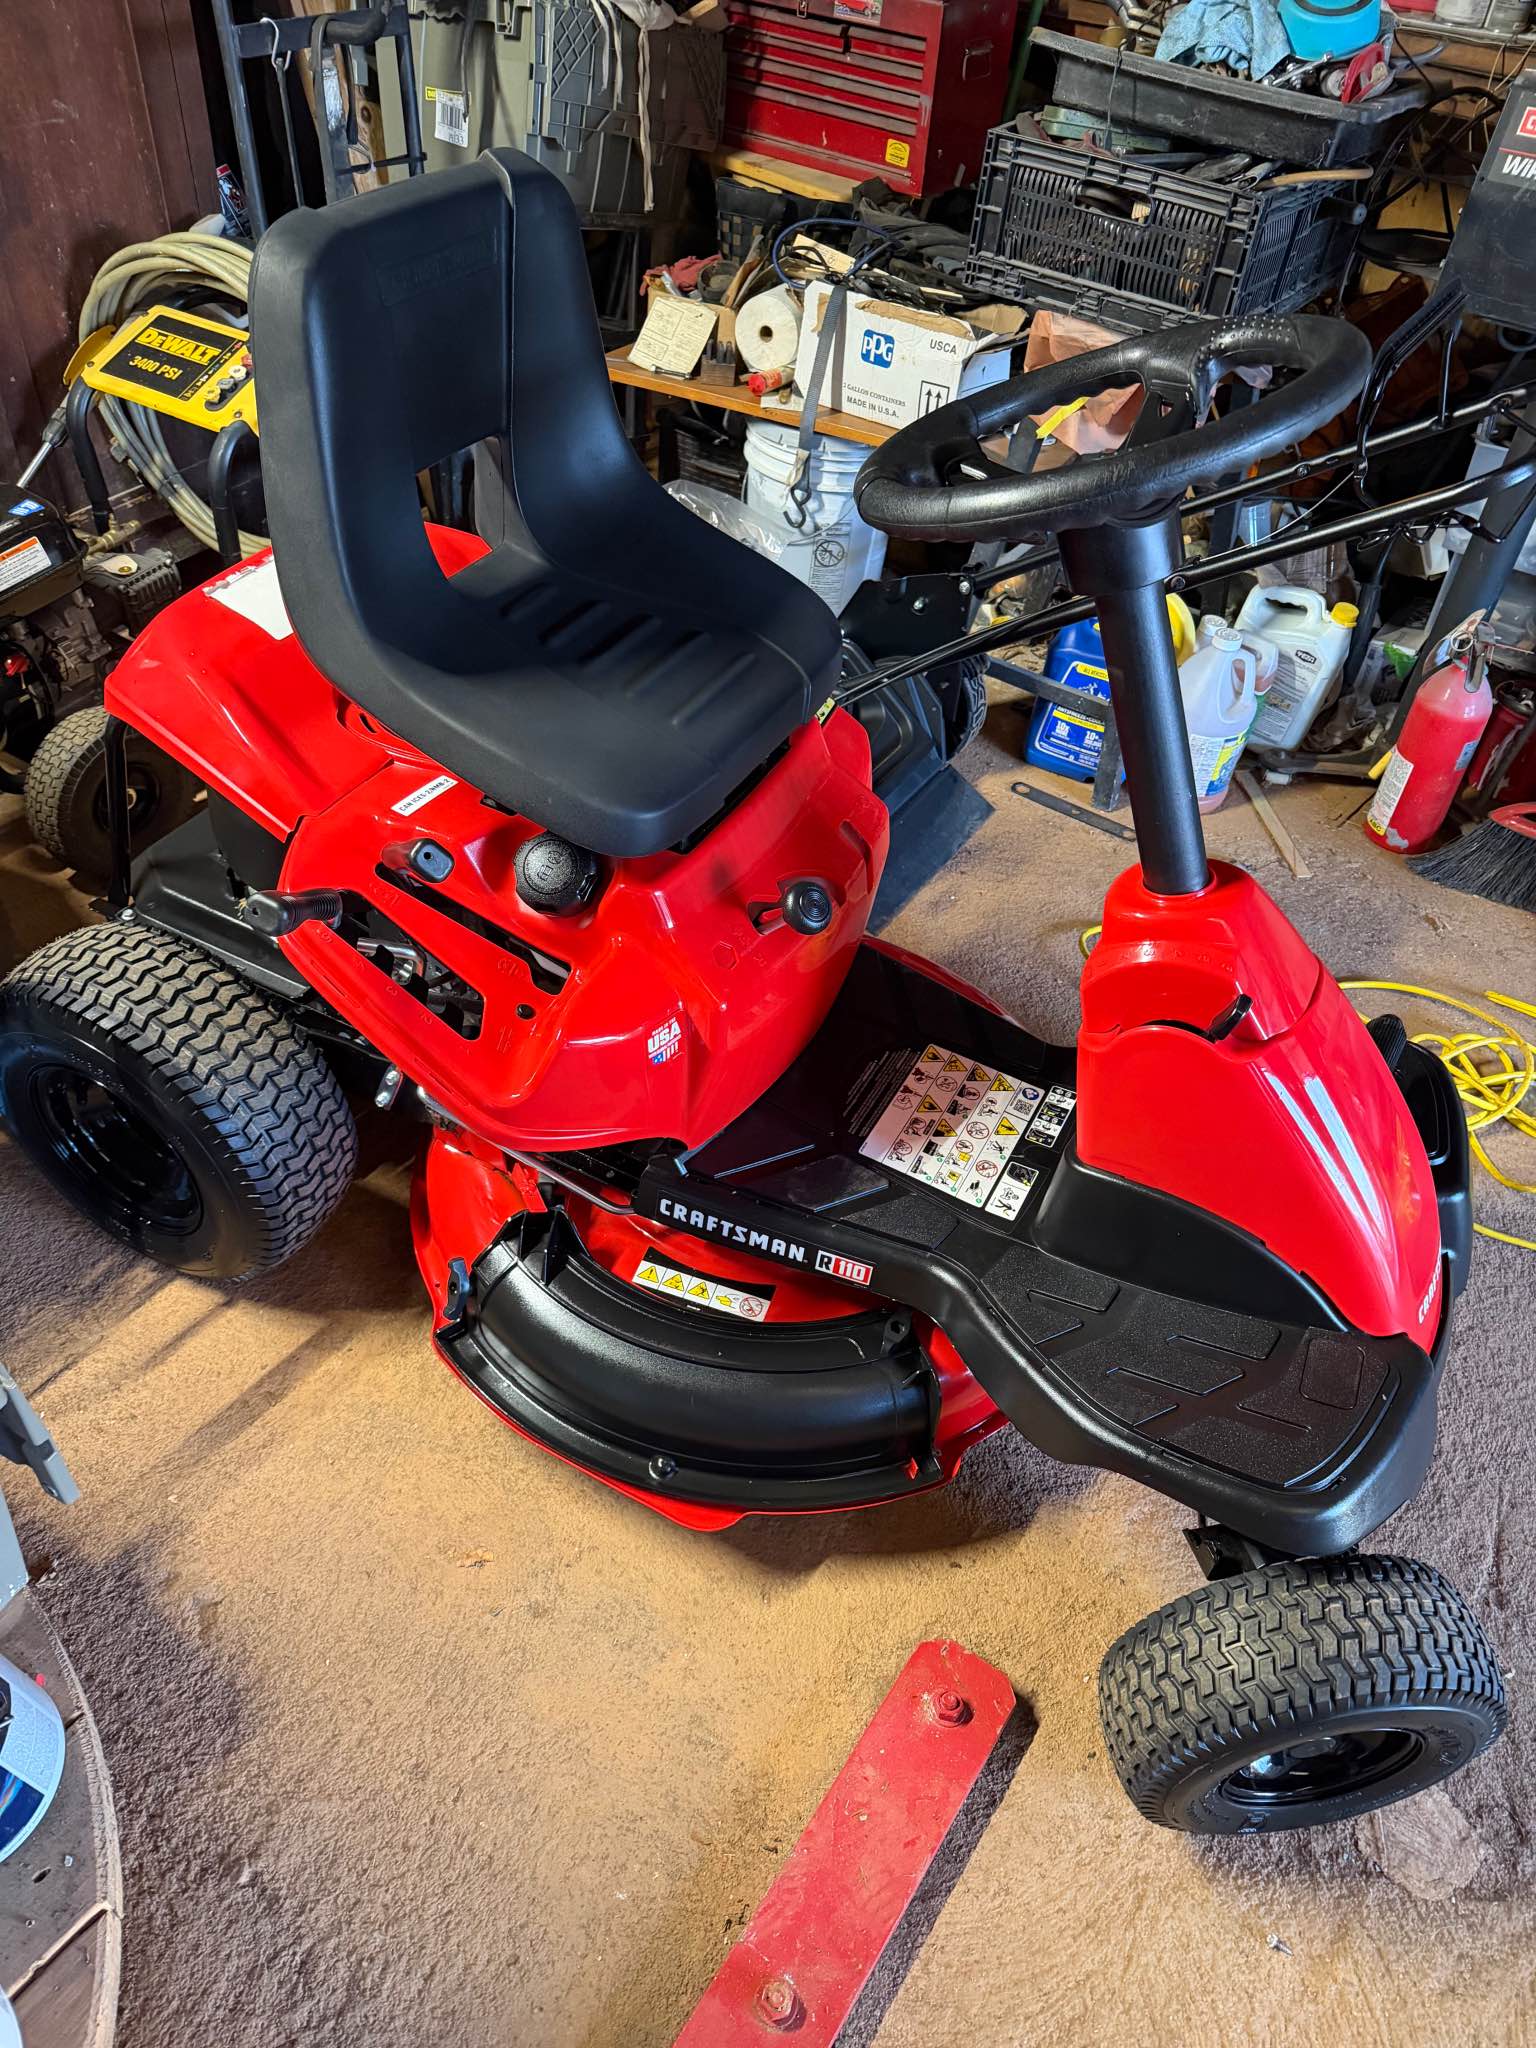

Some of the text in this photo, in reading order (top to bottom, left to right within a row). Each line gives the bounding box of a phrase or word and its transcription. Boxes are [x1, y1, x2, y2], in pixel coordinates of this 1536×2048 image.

[137, 328, 220, 364] DEWALT
[862, 333, 894, 362] PPG
[930, 339, 957, 355] USCA
[129, 355, 183, 381] 3400 PSI
[847, 383, 869, 396] GALLON
[870, 391, 906, 407] CONTAINERS
[847, 396, 900, 418] MADE IN U.S.A.
[648, 1021, 681, 1053] USA
[659, 1198, 806, 1263] CRAFTSMAN
